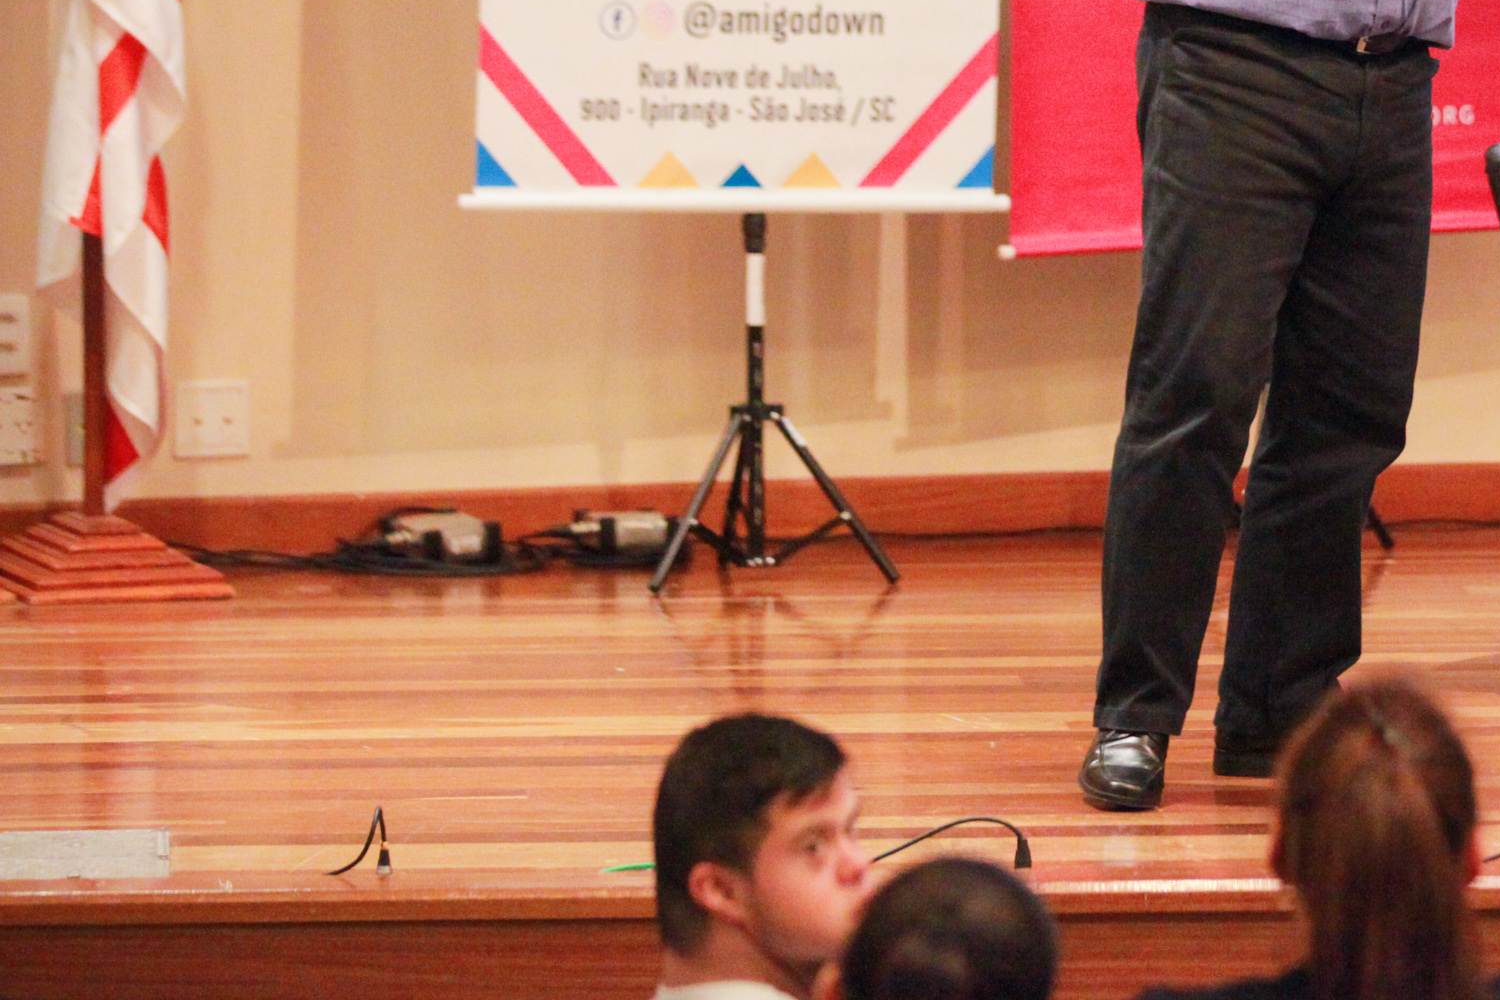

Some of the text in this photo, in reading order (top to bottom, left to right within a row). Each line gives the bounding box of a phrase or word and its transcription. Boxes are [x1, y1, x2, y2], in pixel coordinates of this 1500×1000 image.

[683, 0, 885, 44] @amigodown
[639, 61, 678, 89] Rua
[685, 62, 739, 89] Nove
[744, 63, 770, 90] de
[640, 96, 731, 129] Ipiranga
[749, 96, 788, 122] São
[794, 96, 846, 123] José
[869, 96, 896, 123] SC
